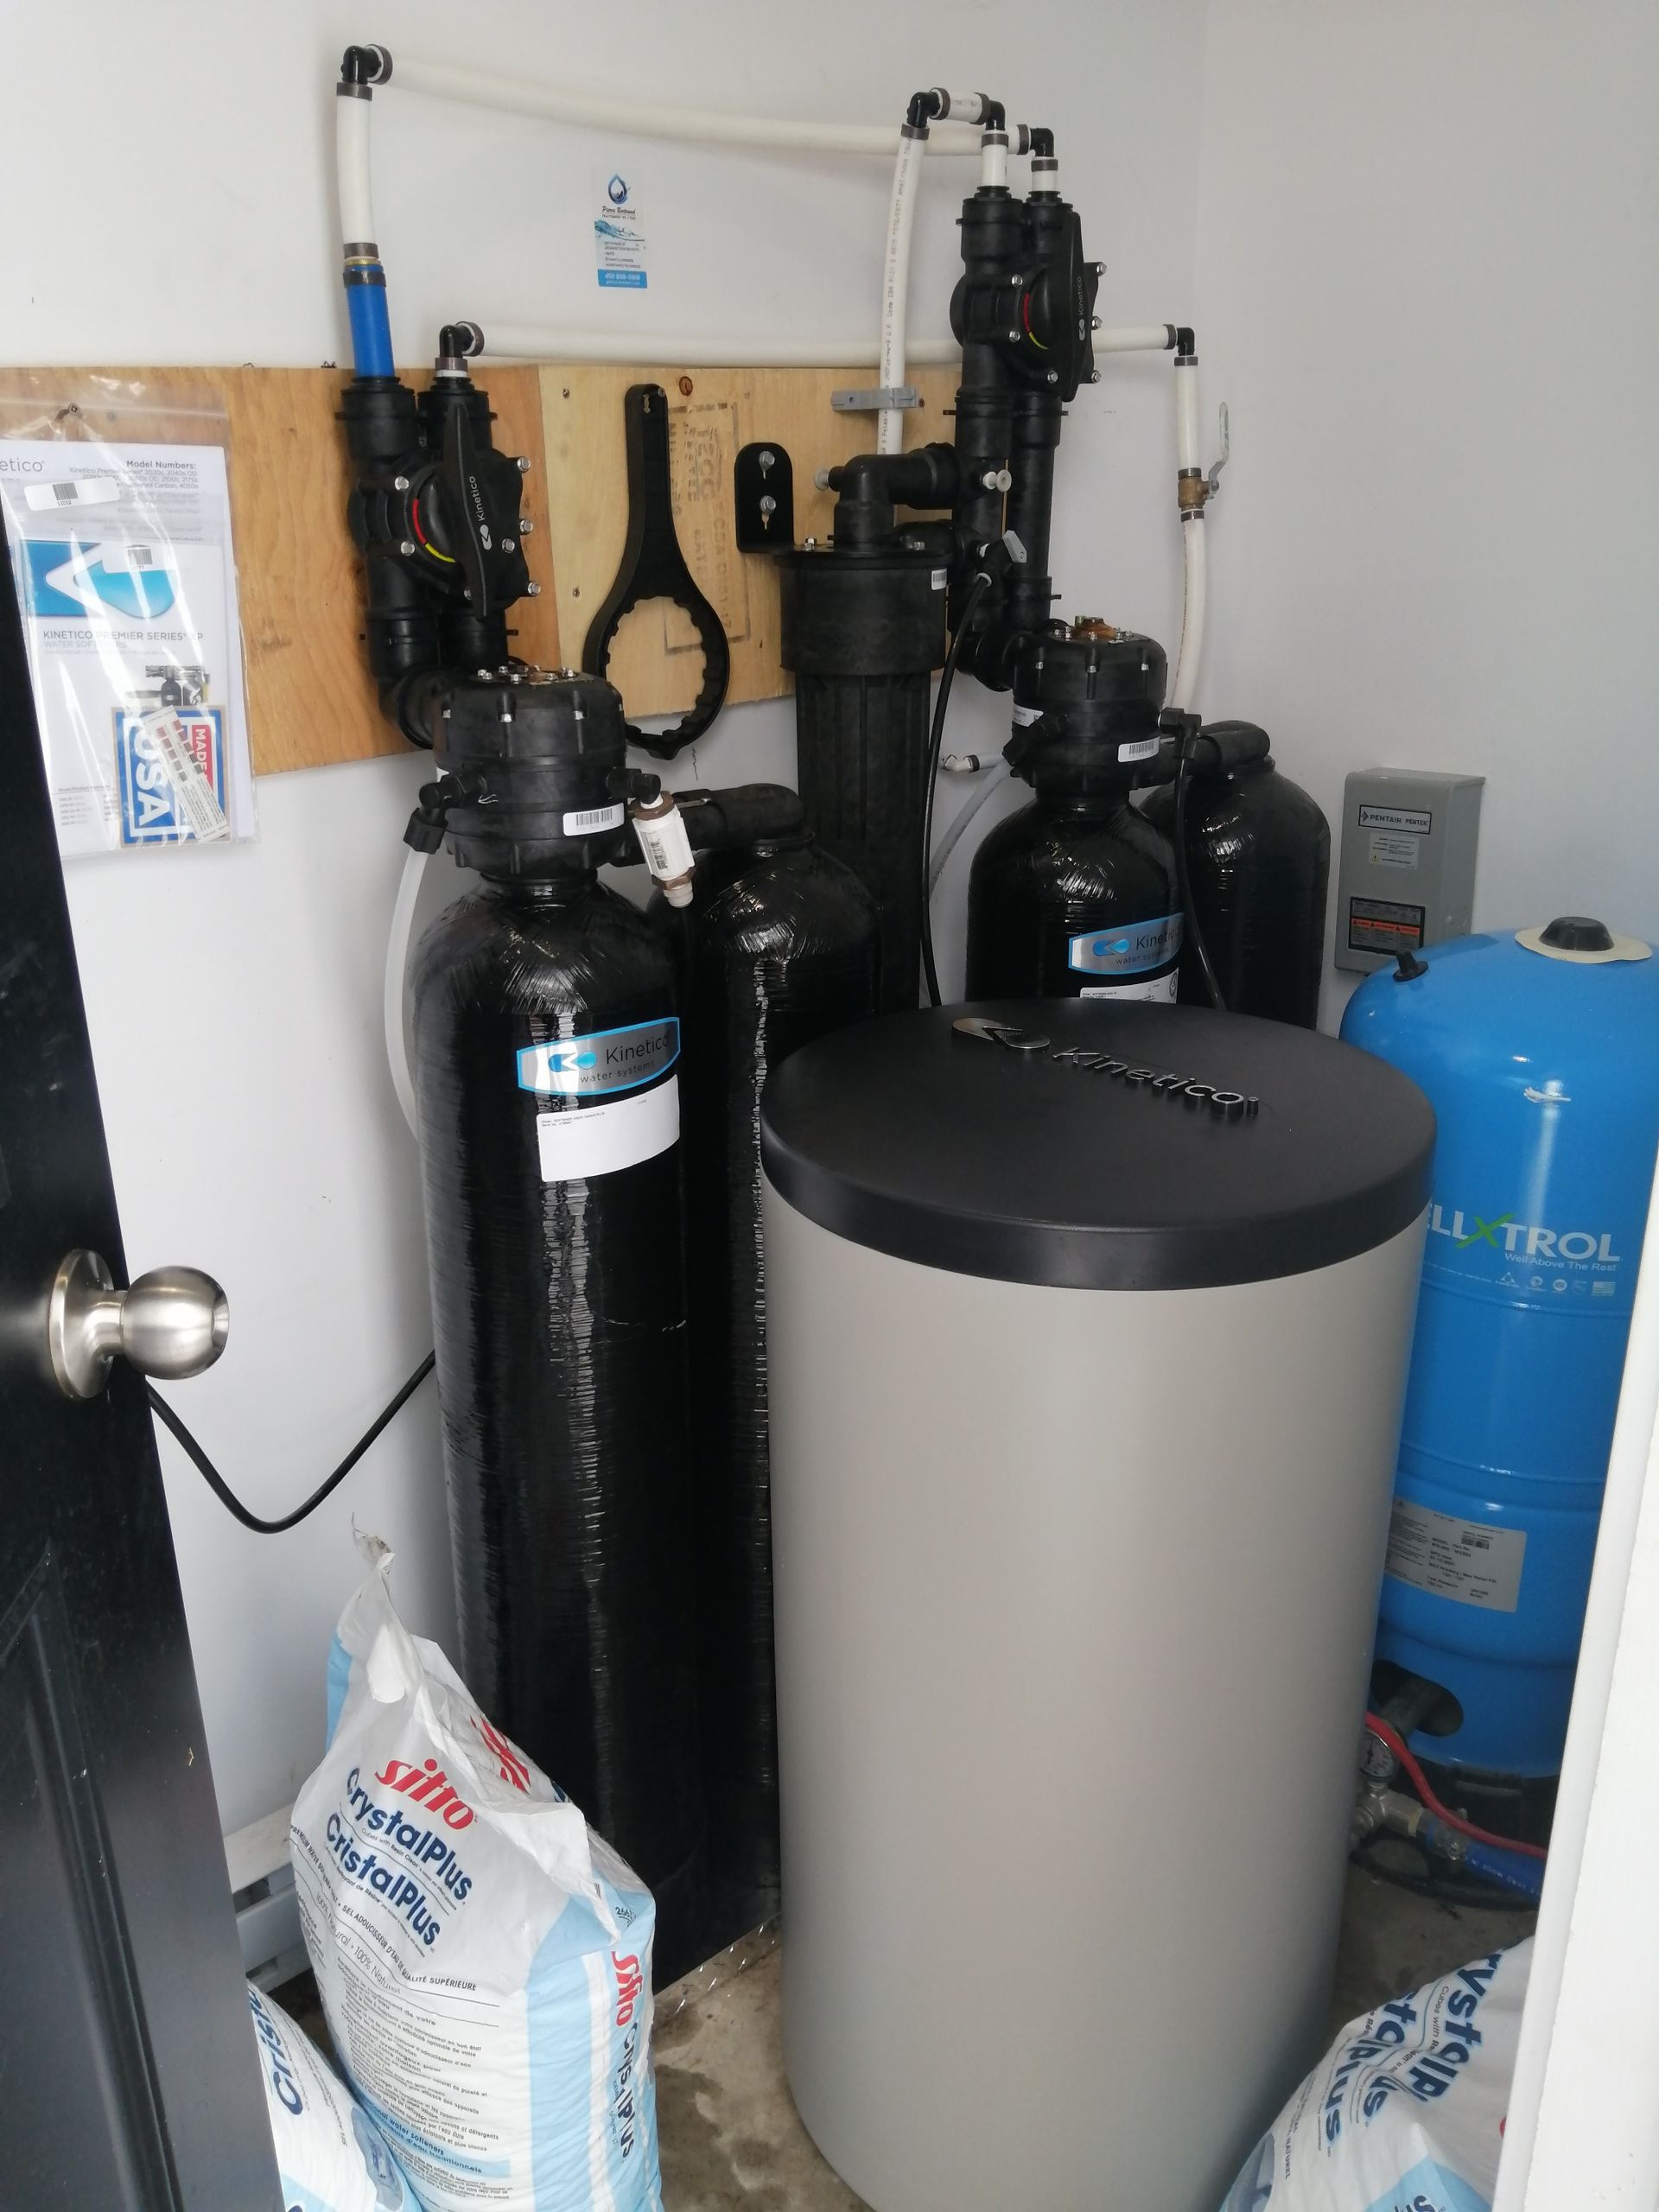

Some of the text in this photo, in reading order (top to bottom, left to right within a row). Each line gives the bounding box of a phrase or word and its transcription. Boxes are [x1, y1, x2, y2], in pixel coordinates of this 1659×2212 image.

[0, 457, 43, 473] etico
[156, 461, 197, 470] Numbers:
[469, 476, 486, 521] Kinetico
[43, 630, 93, 639] KINETICO
[1370, 814, 1402, 823] PENTAIR
[605, 1036, 670, 1065] Kinetico
[580, 1061, 655, 1084] water systems
[1052, 1046, 1244, 1111] Kinetico
[1505, 1253, 1529, 1264] Well
[1529, 1257, 1565, 1268] Above
[1568, 1261, 1588, 1271] The
[346, 1768, 473, 1900] CrystalPlus
[327, 1813, 441, 1945] CristalPlus
[342, 1904, 354, 1917] SEL
[353, 1912, 388, 1949] ADOUCISSEUR
[429, 1974, 477, 1992] SUPÉRIEURE
[353, 1946, 372, 1969] 100%
